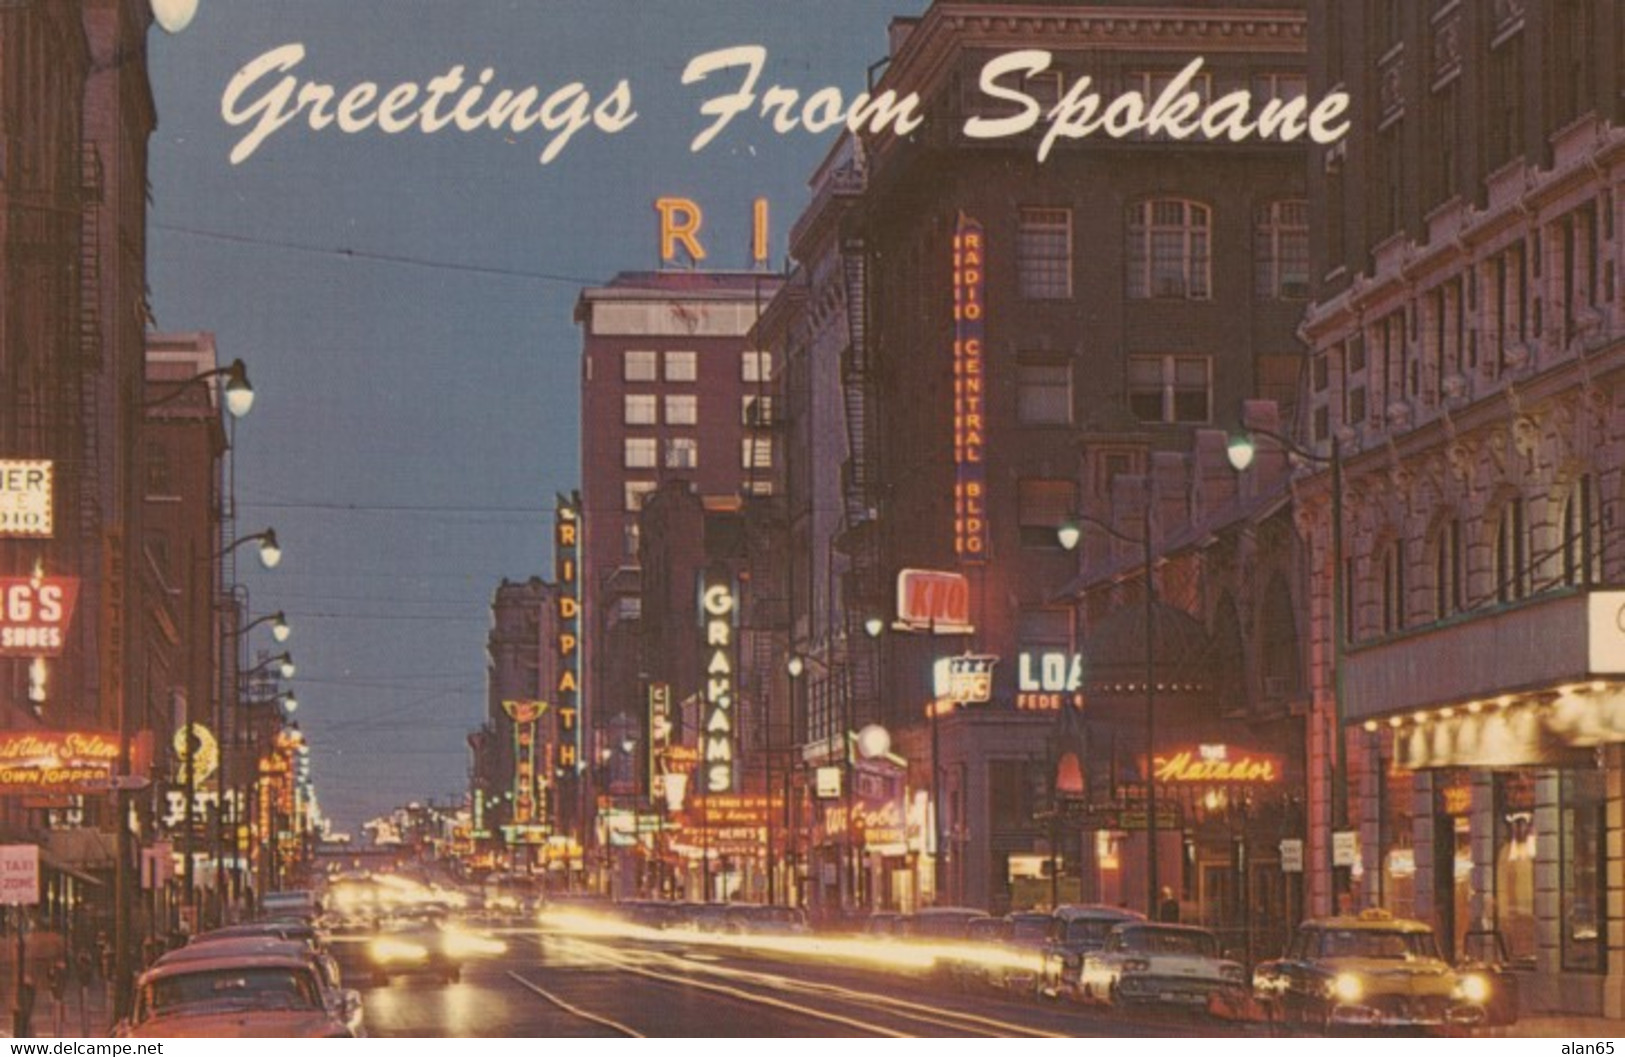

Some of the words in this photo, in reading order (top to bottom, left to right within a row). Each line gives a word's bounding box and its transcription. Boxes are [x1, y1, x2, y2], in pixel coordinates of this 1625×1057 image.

[965, 233, 981, 320] RADIO
[965, 339, 981, 462] CENTRAL
[0, 469, 44, 491] ER
[558, 523, 577, 767] RIDPATH
[1153, 752, 1274, 783] Matador
